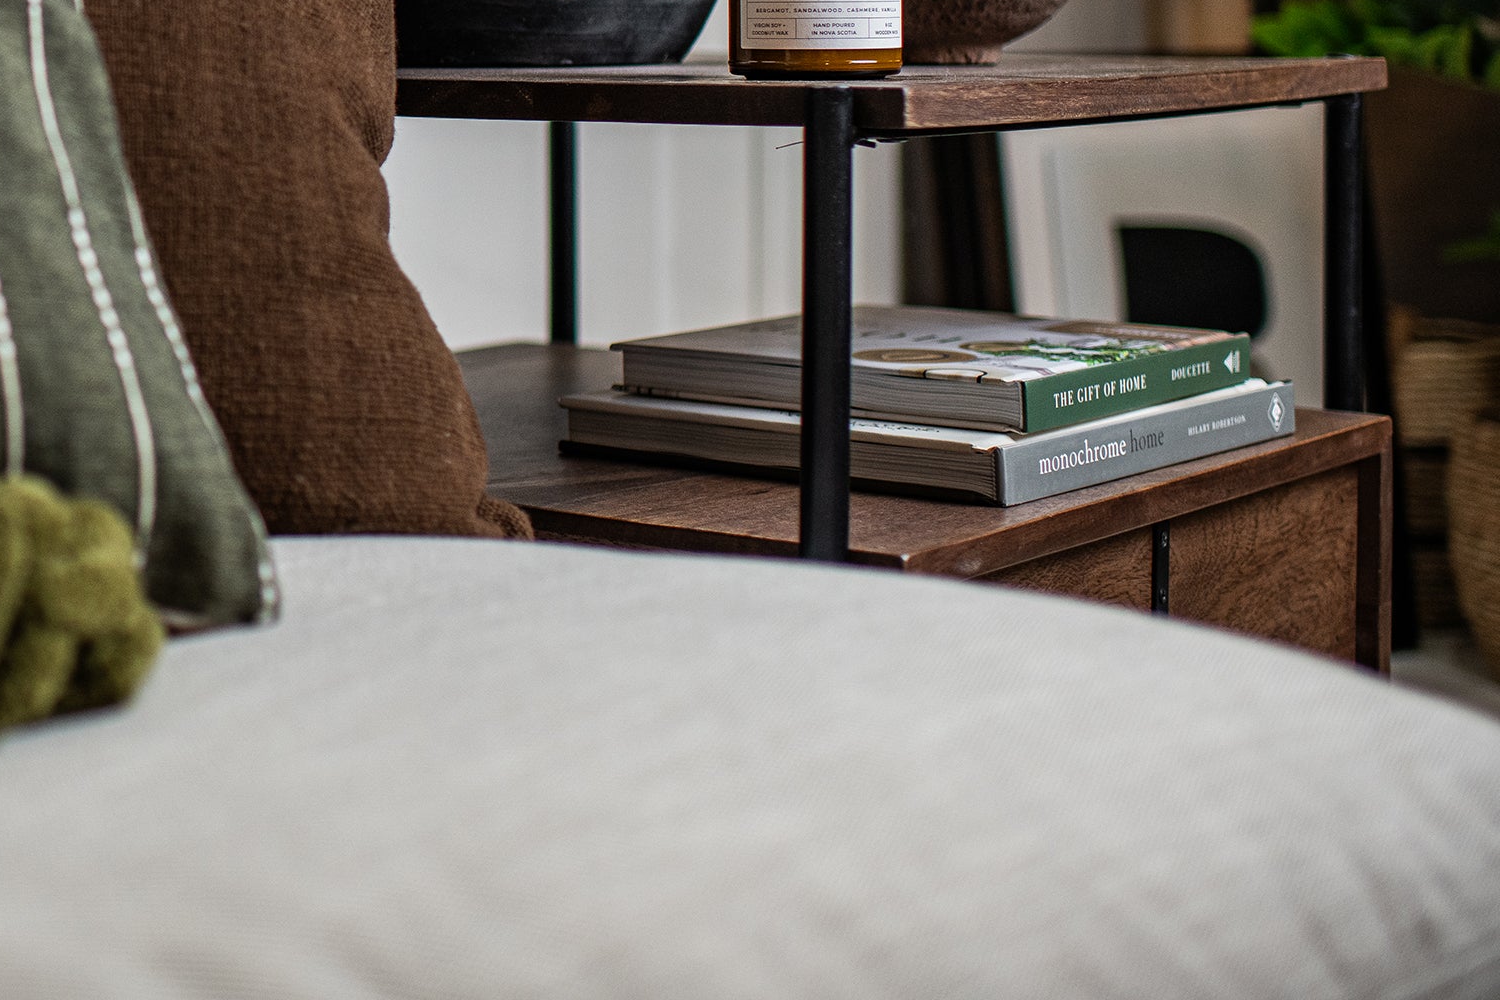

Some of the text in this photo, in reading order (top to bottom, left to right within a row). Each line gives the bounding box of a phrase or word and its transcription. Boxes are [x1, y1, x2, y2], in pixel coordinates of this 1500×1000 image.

[1171, 361, 1210, 381] DOUCETTE
[1054, 374, 1147, 408] THE GIFT OF HOME
[1038, 429, 1164, 475] monochrome home
